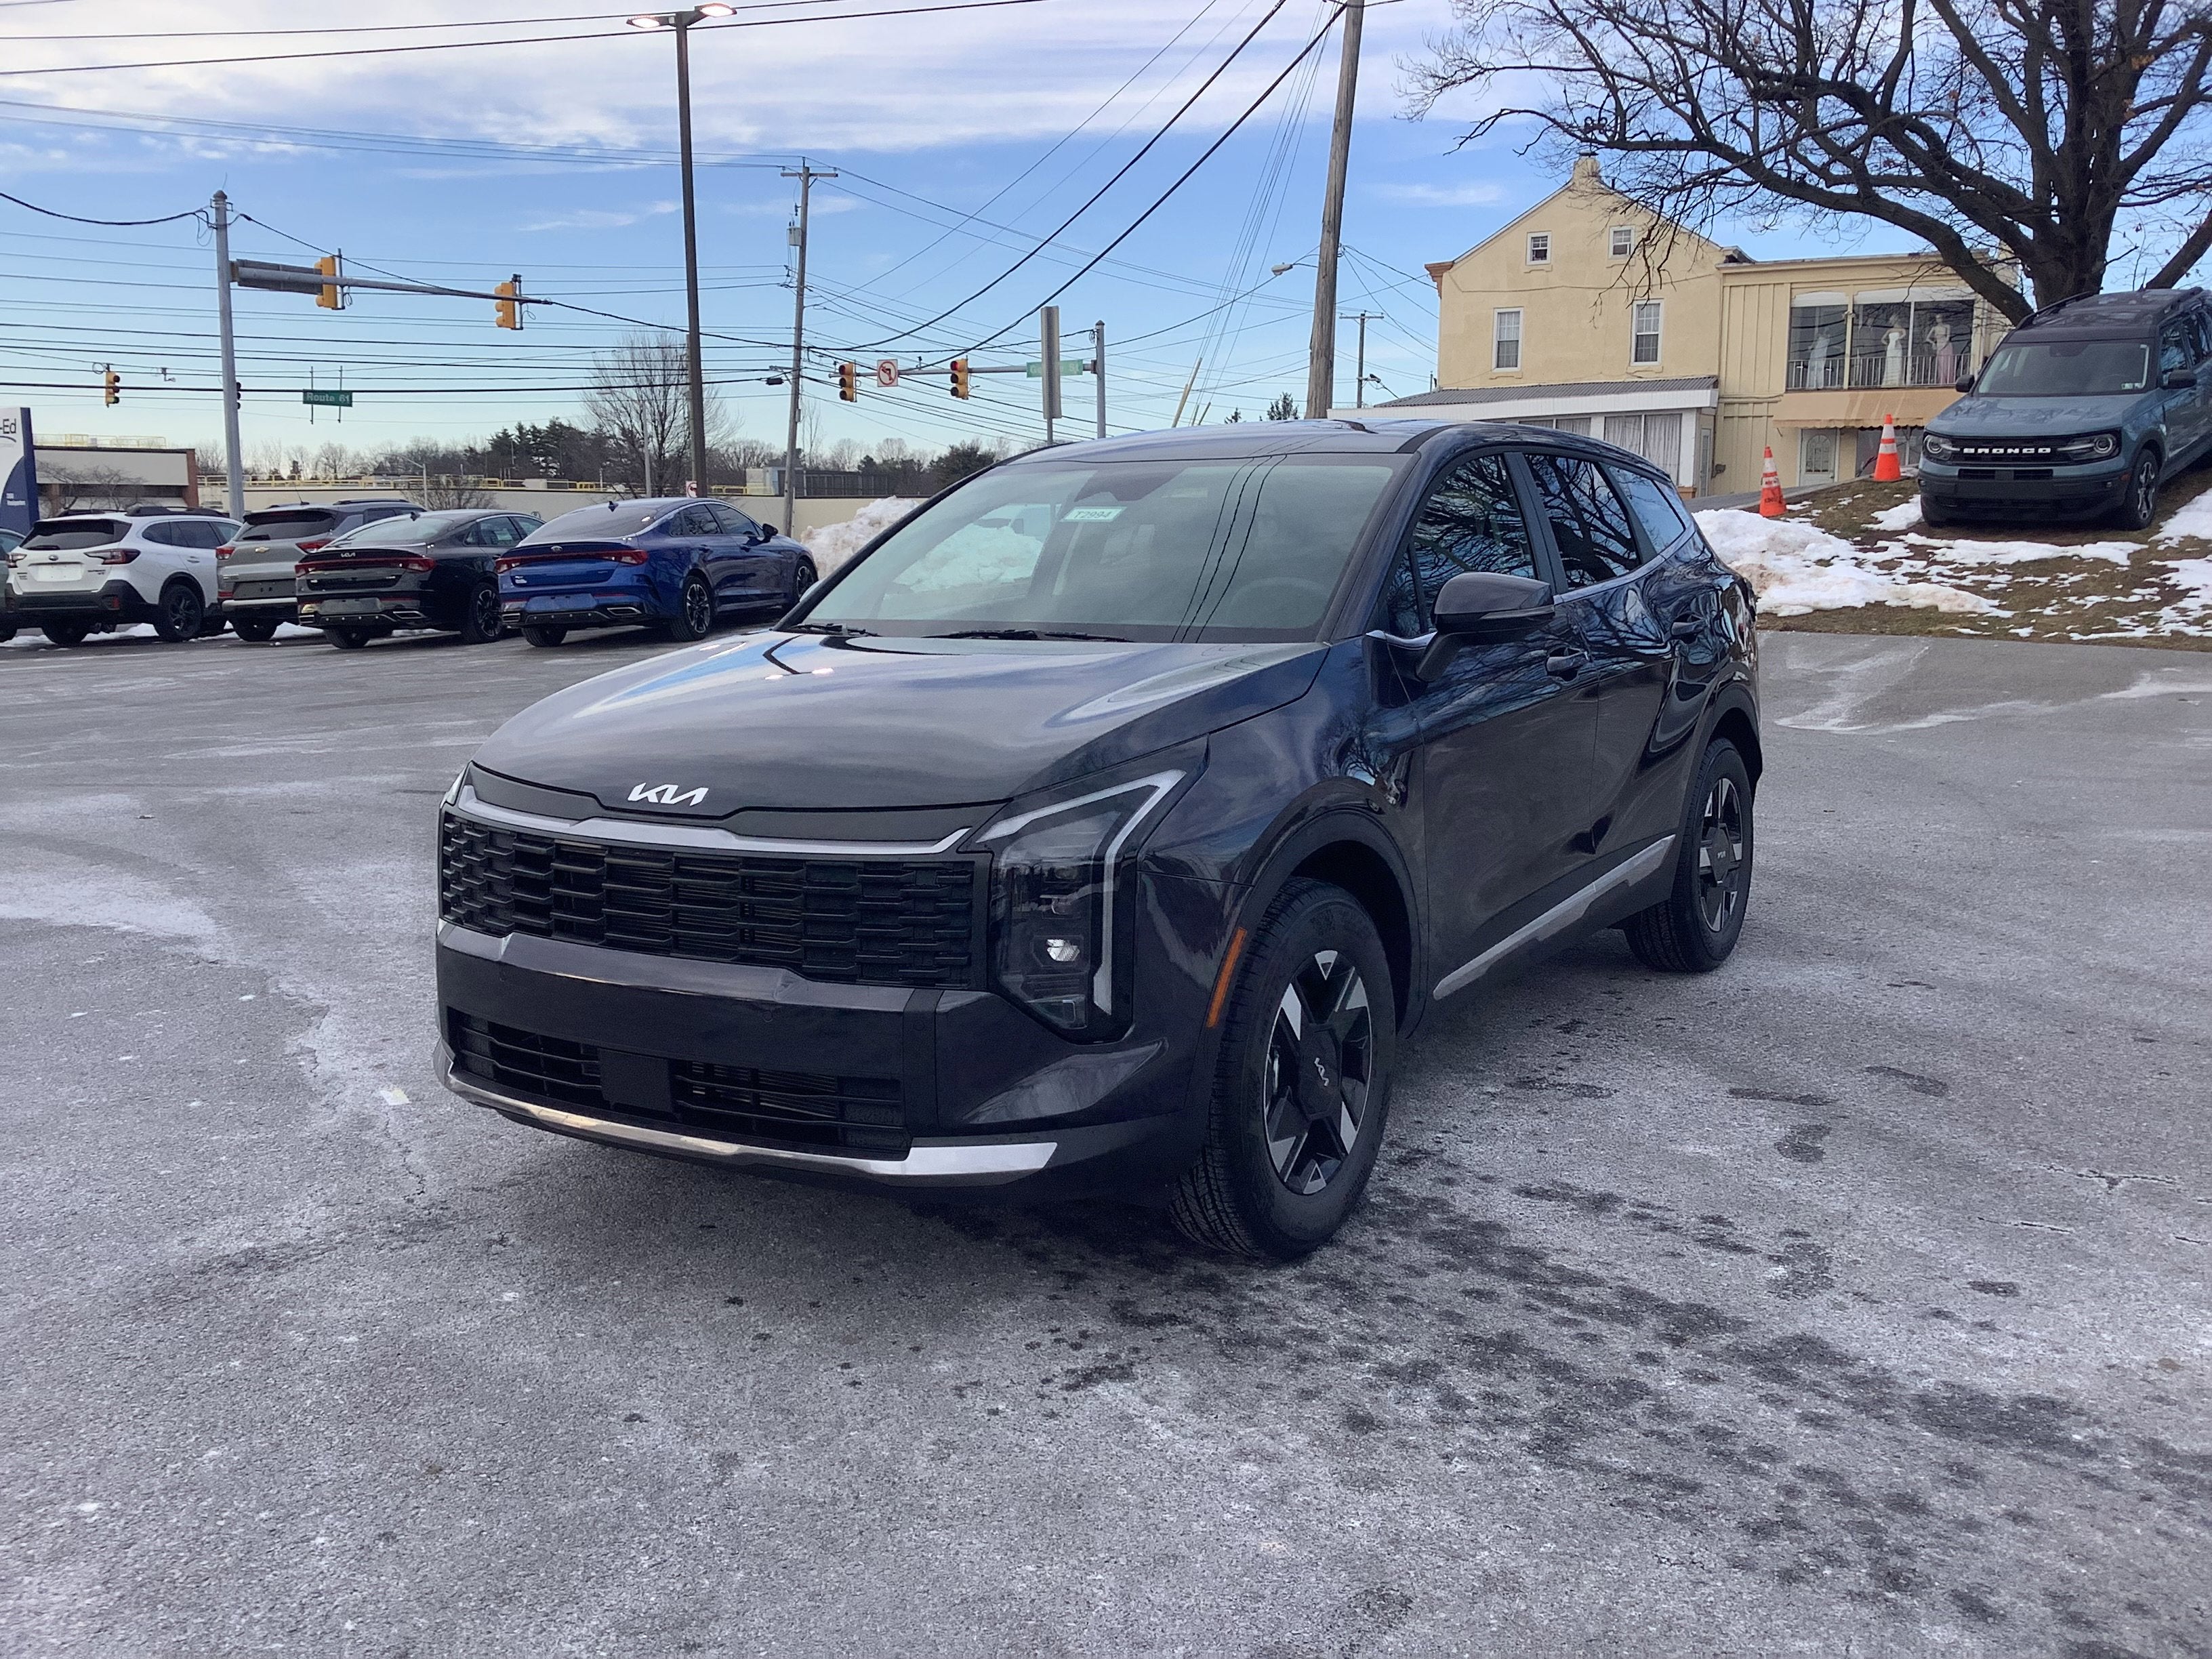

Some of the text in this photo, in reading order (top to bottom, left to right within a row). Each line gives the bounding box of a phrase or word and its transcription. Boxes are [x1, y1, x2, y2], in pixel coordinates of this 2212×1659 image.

[306, 393, 351, 403] Route 61
[1074, 511, 1113, 519] T2994
[628, 782, 709, 806] KIA
